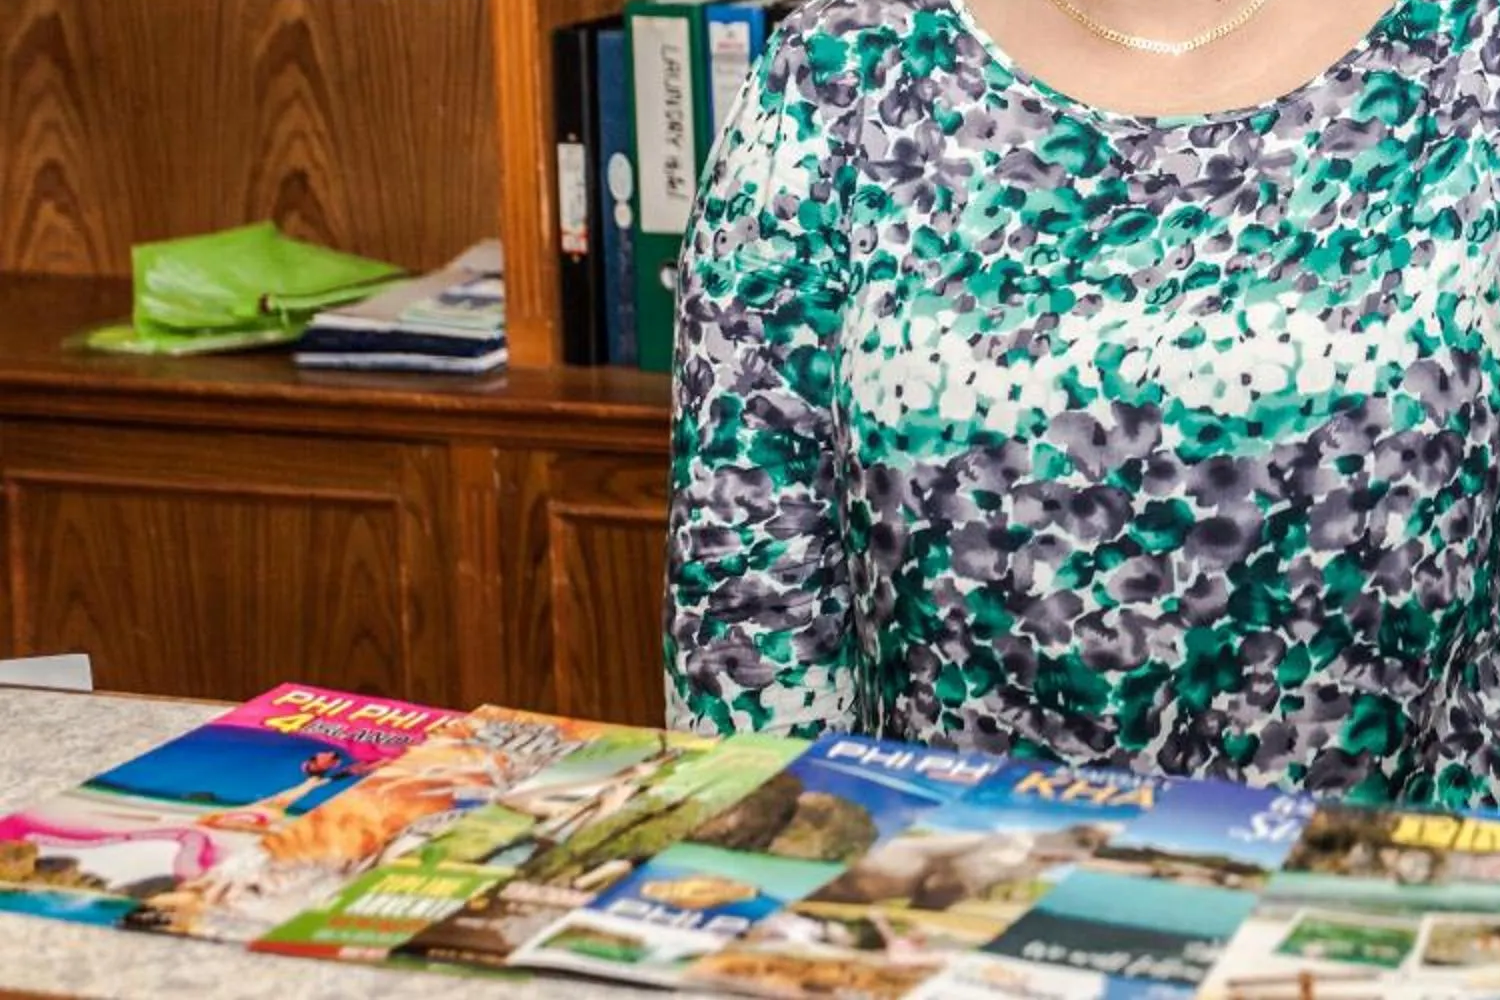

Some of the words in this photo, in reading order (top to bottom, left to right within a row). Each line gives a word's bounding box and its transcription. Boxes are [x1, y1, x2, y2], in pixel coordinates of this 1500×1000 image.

[273, 690, 352, 717] PHI
[350, 703, 430, 730] PHI
[826, 740, 914, 769] PHI
